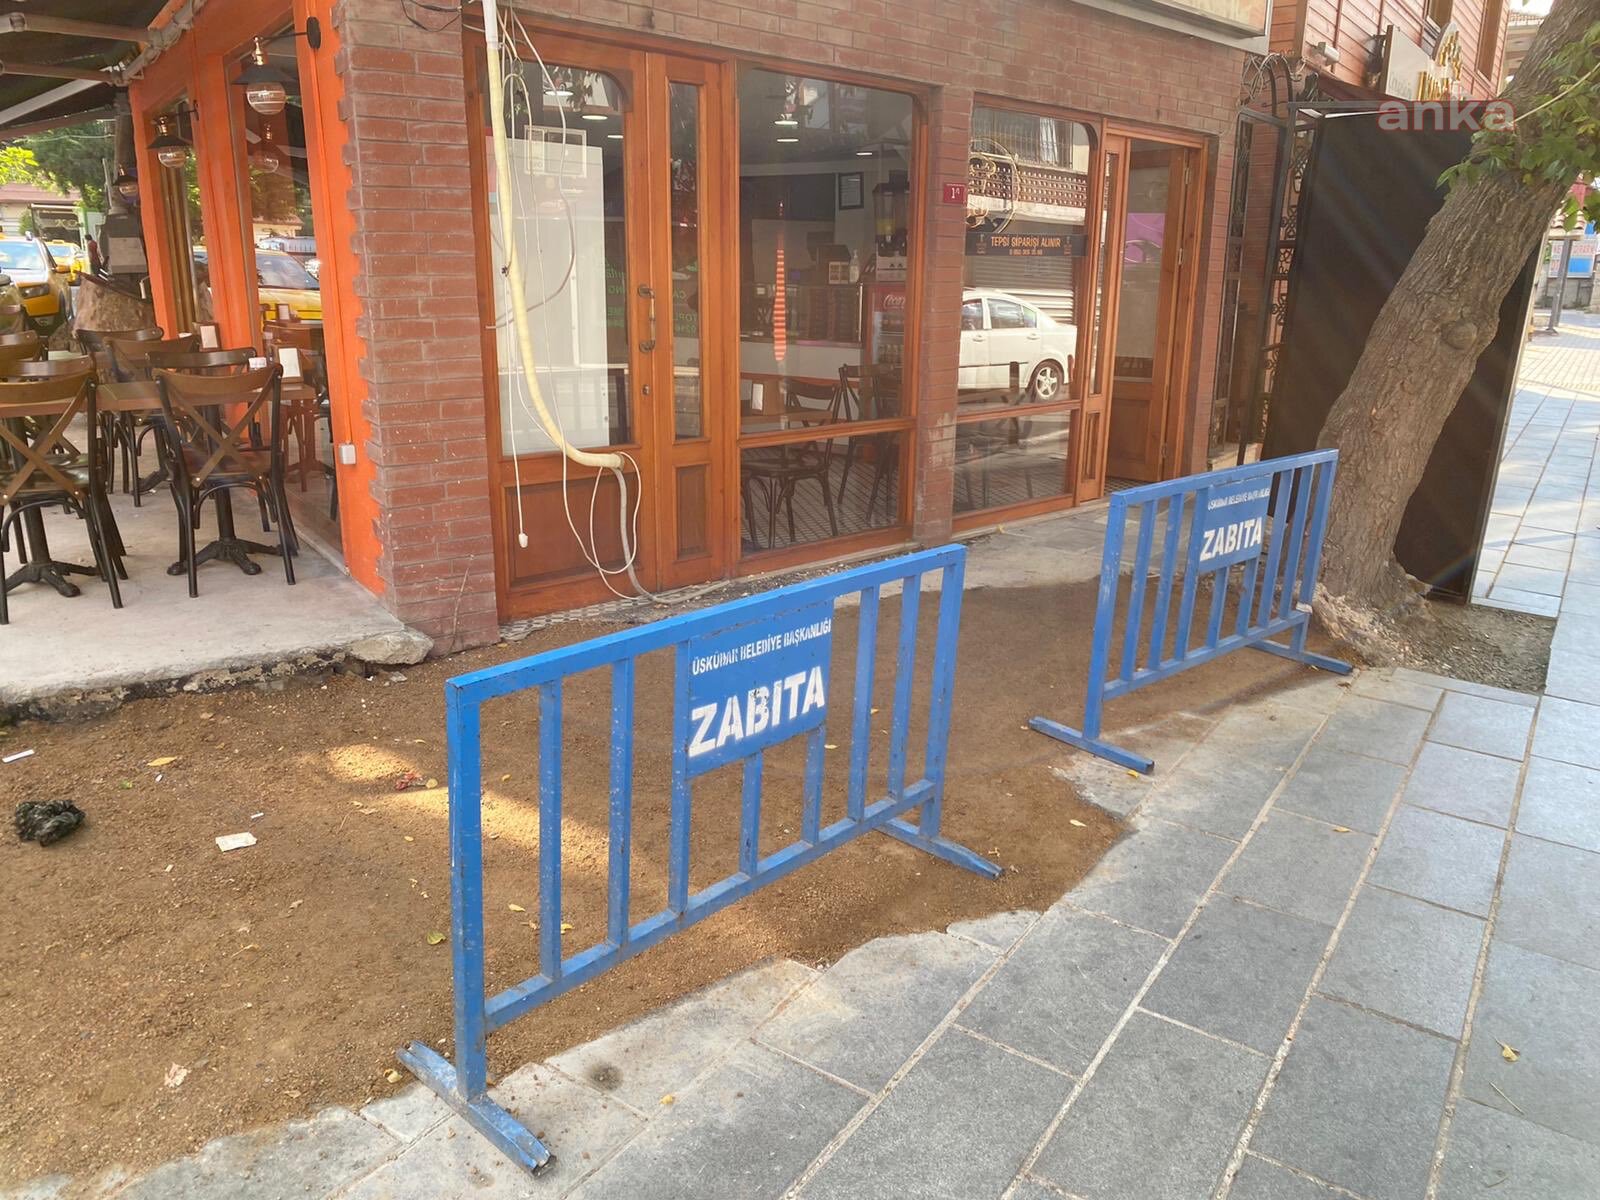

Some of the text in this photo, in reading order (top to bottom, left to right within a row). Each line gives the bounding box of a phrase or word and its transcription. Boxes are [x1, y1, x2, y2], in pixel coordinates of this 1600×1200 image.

[991, 235, 1010, 247] TEPSİ
[1041, 237, 1061, 248] ALINIR
[1200, 517, 1262, 562] ZABITA
[740, 634, 782, 661] BELEDİYE
[783, 617, 832, 648] BAŞKANLIĞI
[688, 666, 825, 758] ZABITA
